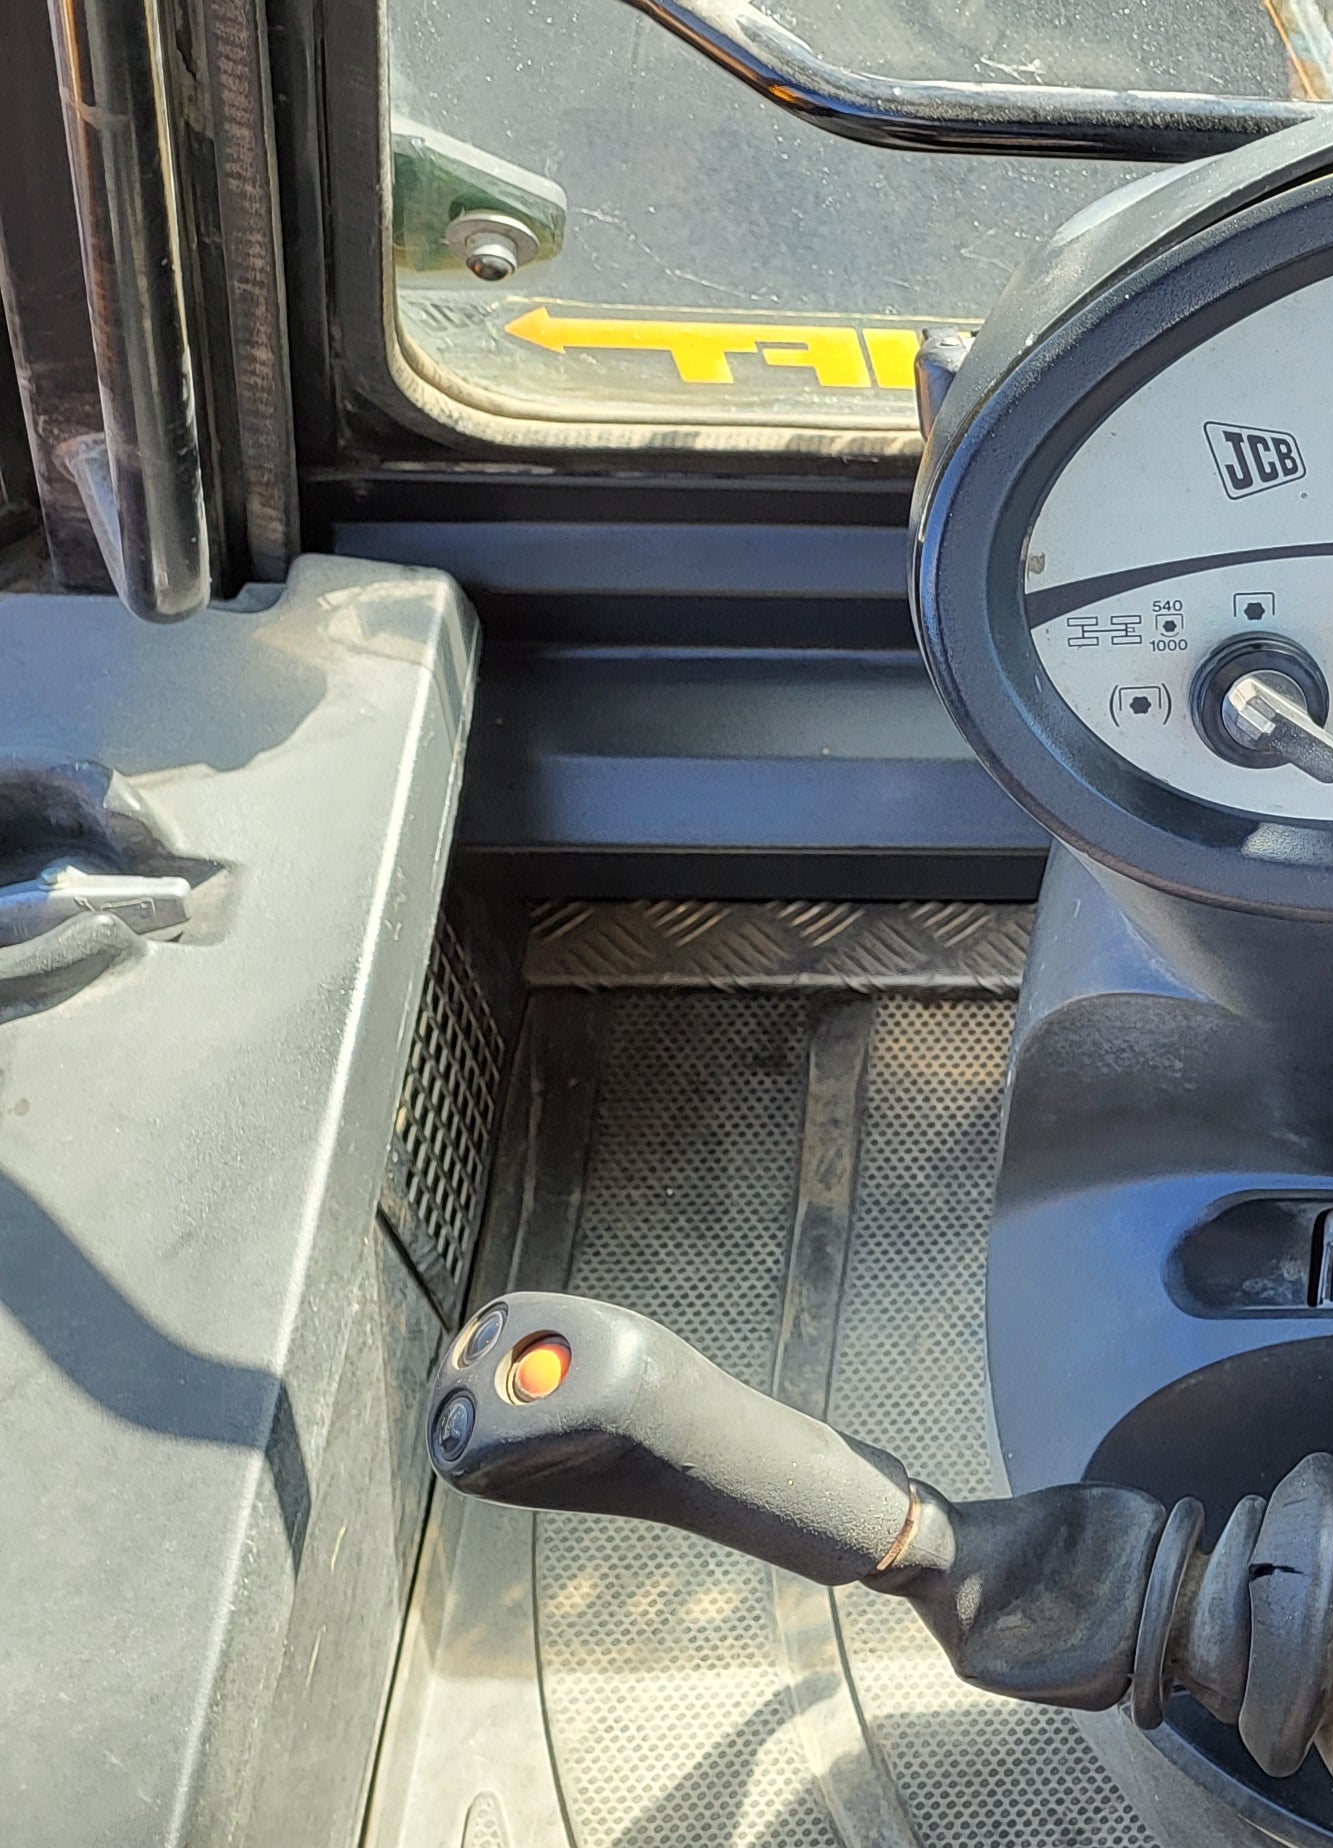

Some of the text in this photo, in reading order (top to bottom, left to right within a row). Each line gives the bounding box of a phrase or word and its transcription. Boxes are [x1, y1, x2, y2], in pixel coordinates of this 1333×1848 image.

[1221, 430, 1299, 491] JCB
[1151, 600, 1184, 613] 540
[1148, 638, 1189, 653] 1000
